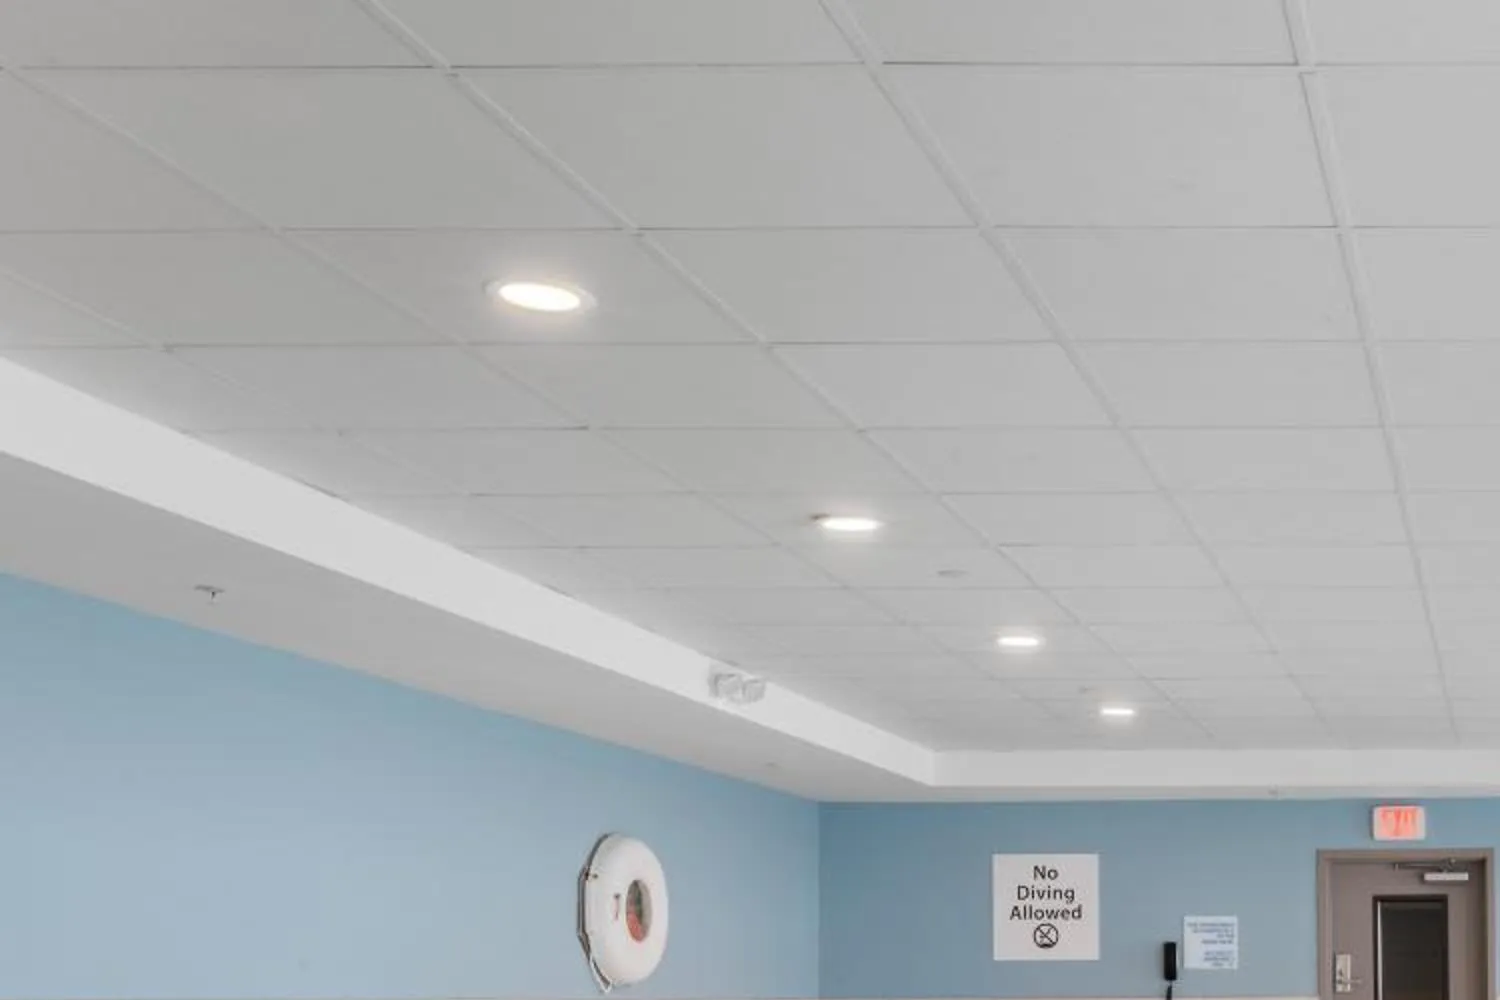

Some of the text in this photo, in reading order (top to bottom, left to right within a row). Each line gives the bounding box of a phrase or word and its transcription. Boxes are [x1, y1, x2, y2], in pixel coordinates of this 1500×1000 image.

[1033, 865, 1059, 880] No
[1017, 884, 1075, 904] Diving
[1009, 904, 1083, 920] Allowed
